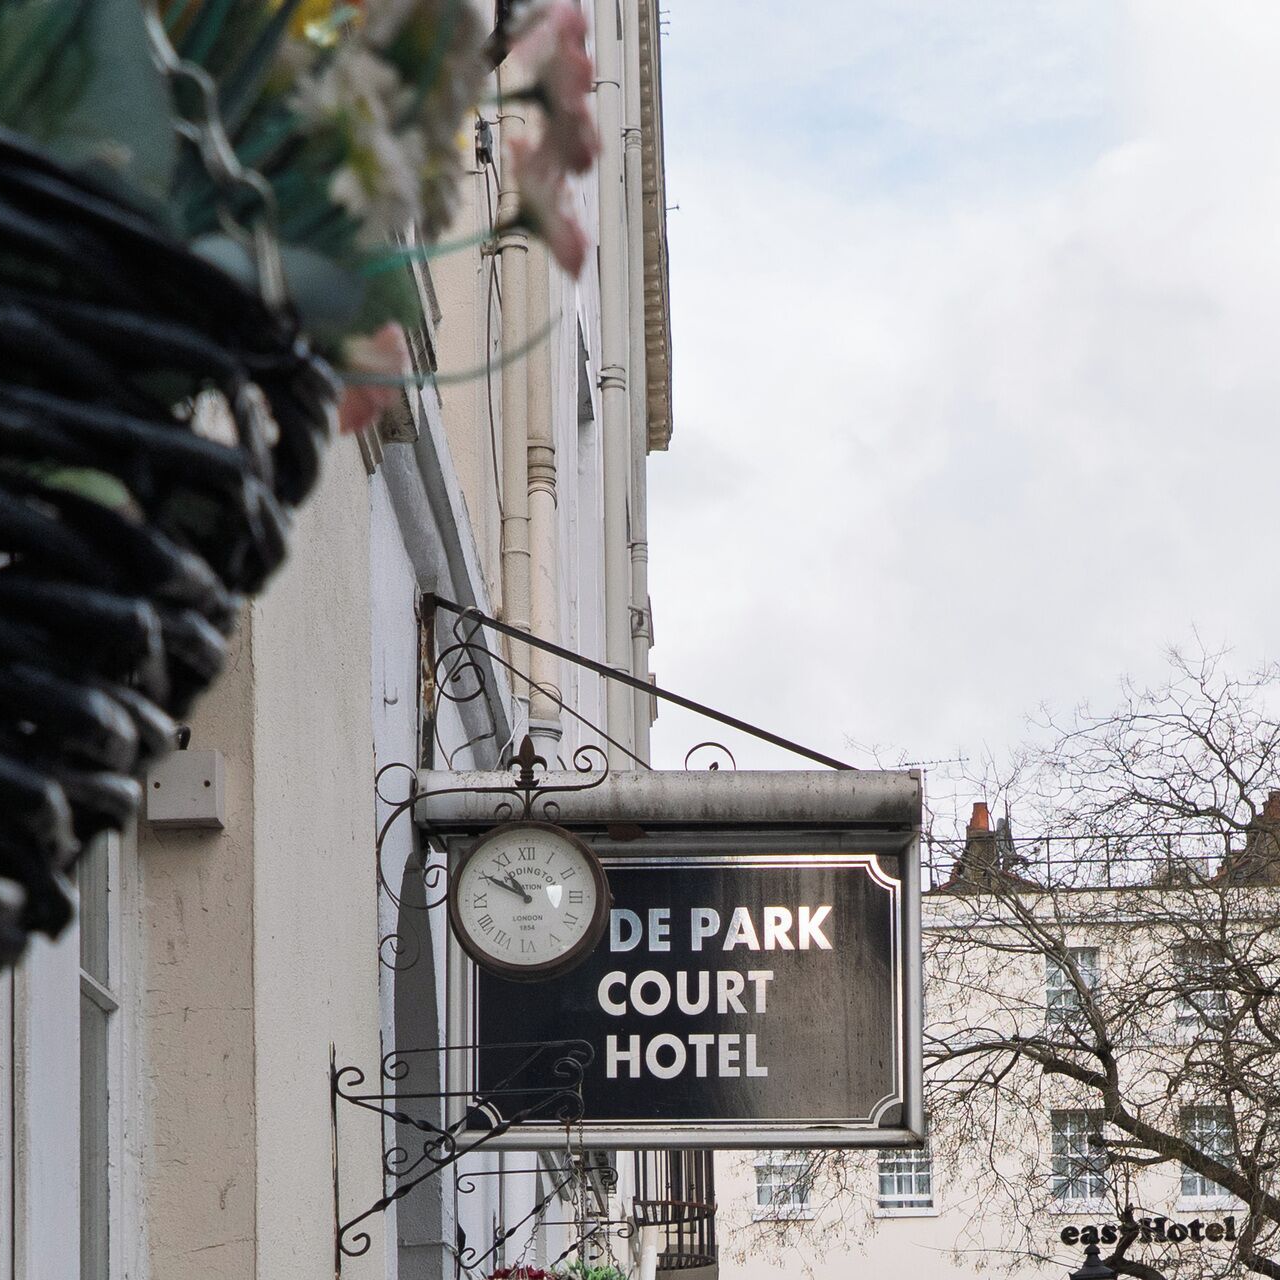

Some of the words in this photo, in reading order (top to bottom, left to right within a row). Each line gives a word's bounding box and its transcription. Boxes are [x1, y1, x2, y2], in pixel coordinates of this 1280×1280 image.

[492, 852, 511, 871] XI
[518, 847, 536, 860] XII
[501, 866, 558, 886] ADDINGTO
[560, 867, 576, 880] II
[513, 914, 543, 922] LONDON
[609, 907, 671, 952] DE
[690, 905, 833, 952] PARK
[597, 970, 774, 1017] COURT
[606, 1033, 769, 1080] HOTEL
[1060, 1215, 1238, 1246] easHotel
